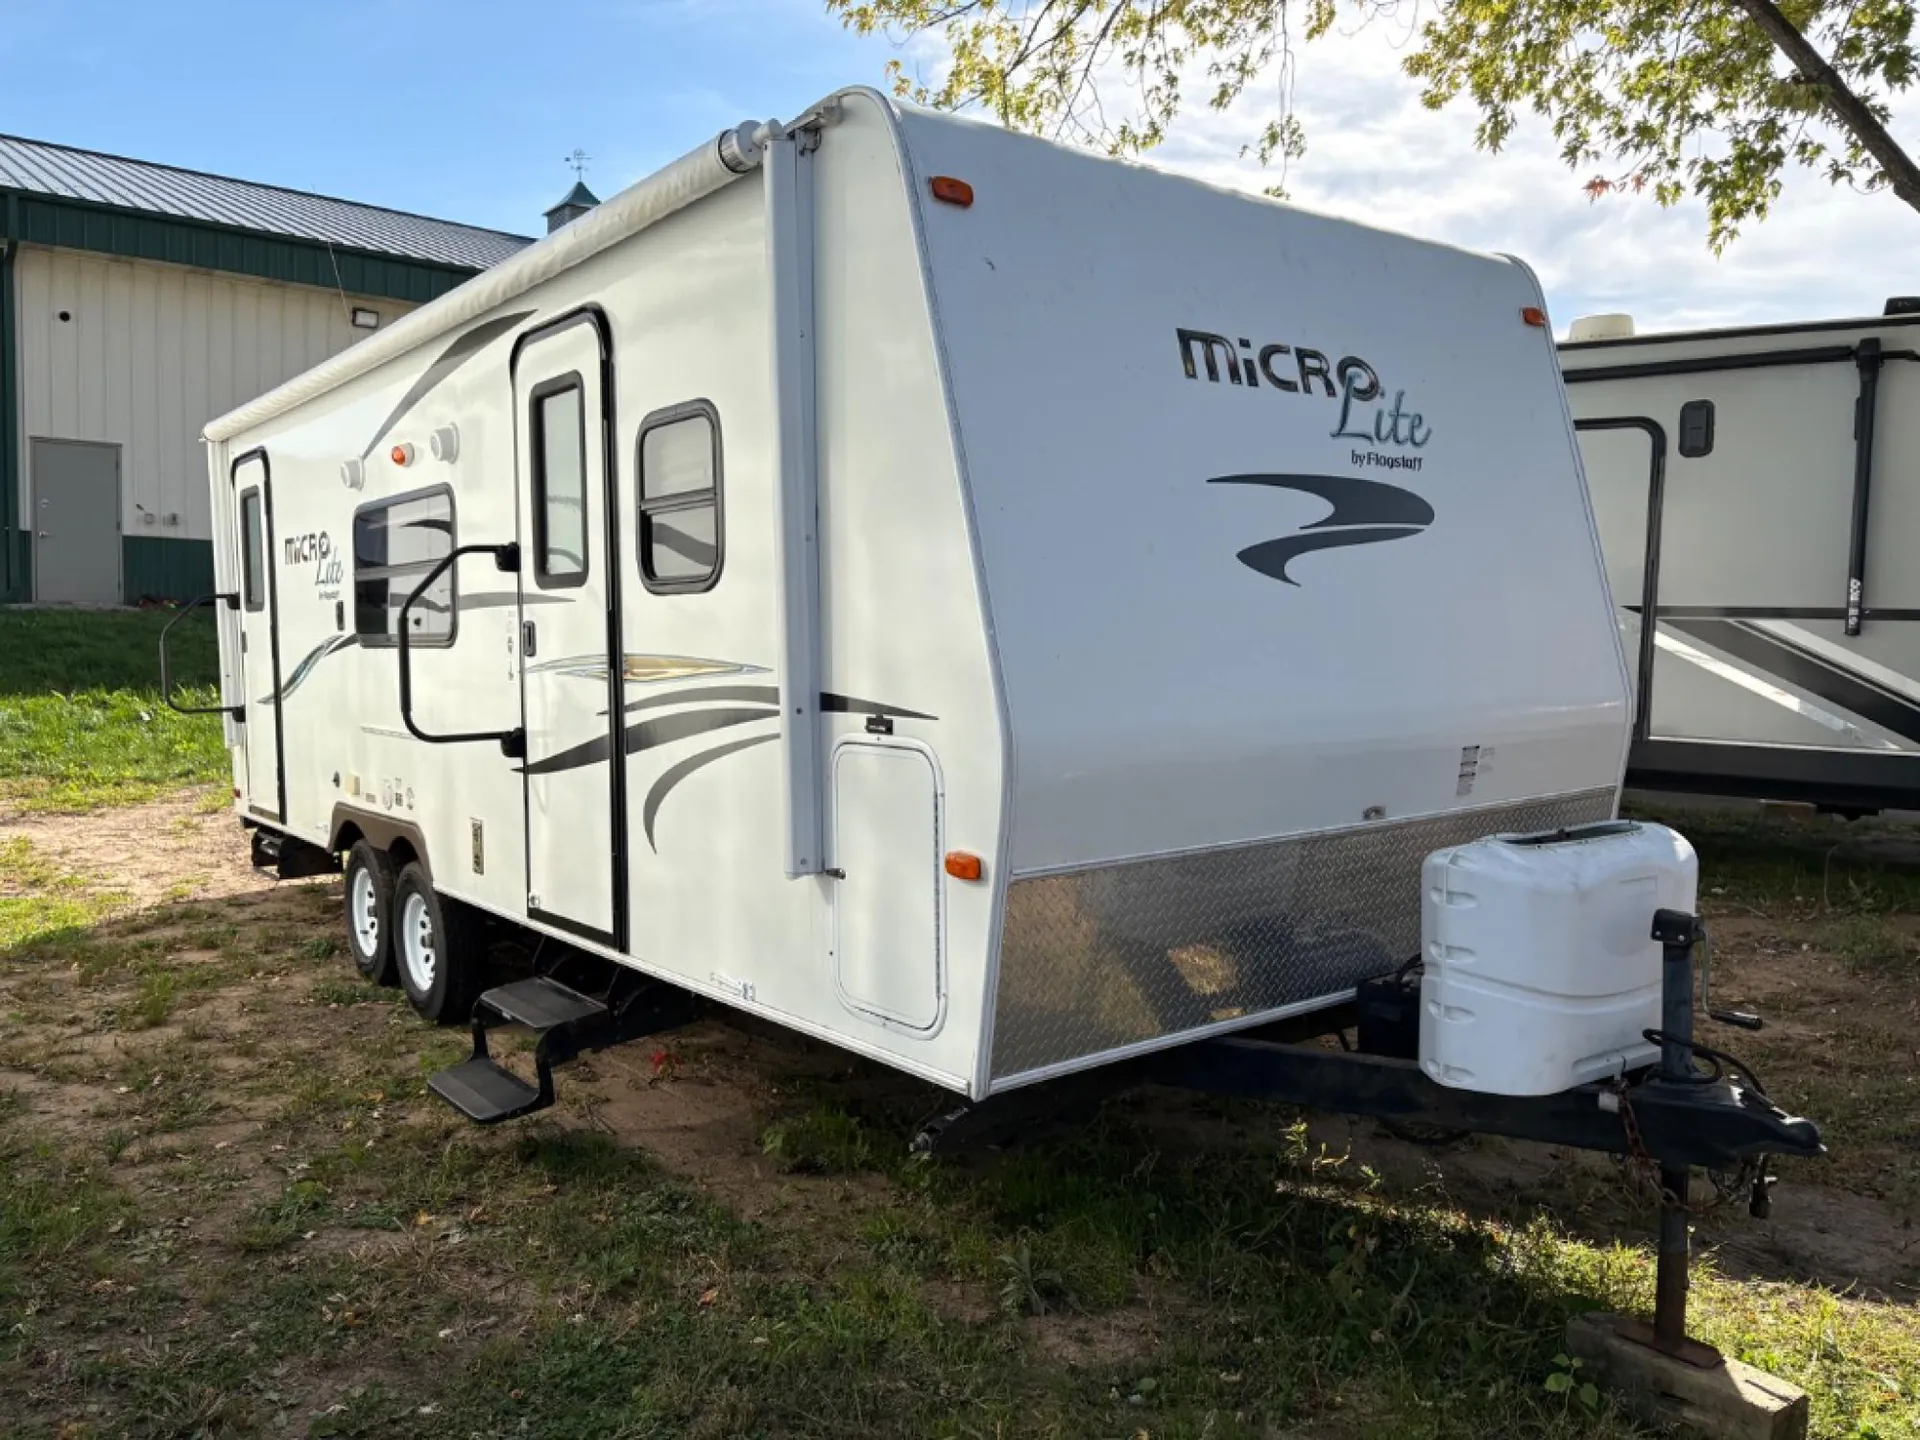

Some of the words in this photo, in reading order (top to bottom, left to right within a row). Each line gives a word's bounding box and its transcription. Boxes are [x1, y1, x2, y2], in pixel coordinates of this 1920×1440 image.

[1330, 370, 1432, 447] Lite
[1351, 449, 1365, 468] by
[1366, 451, 1423, 472] Flagstaff
